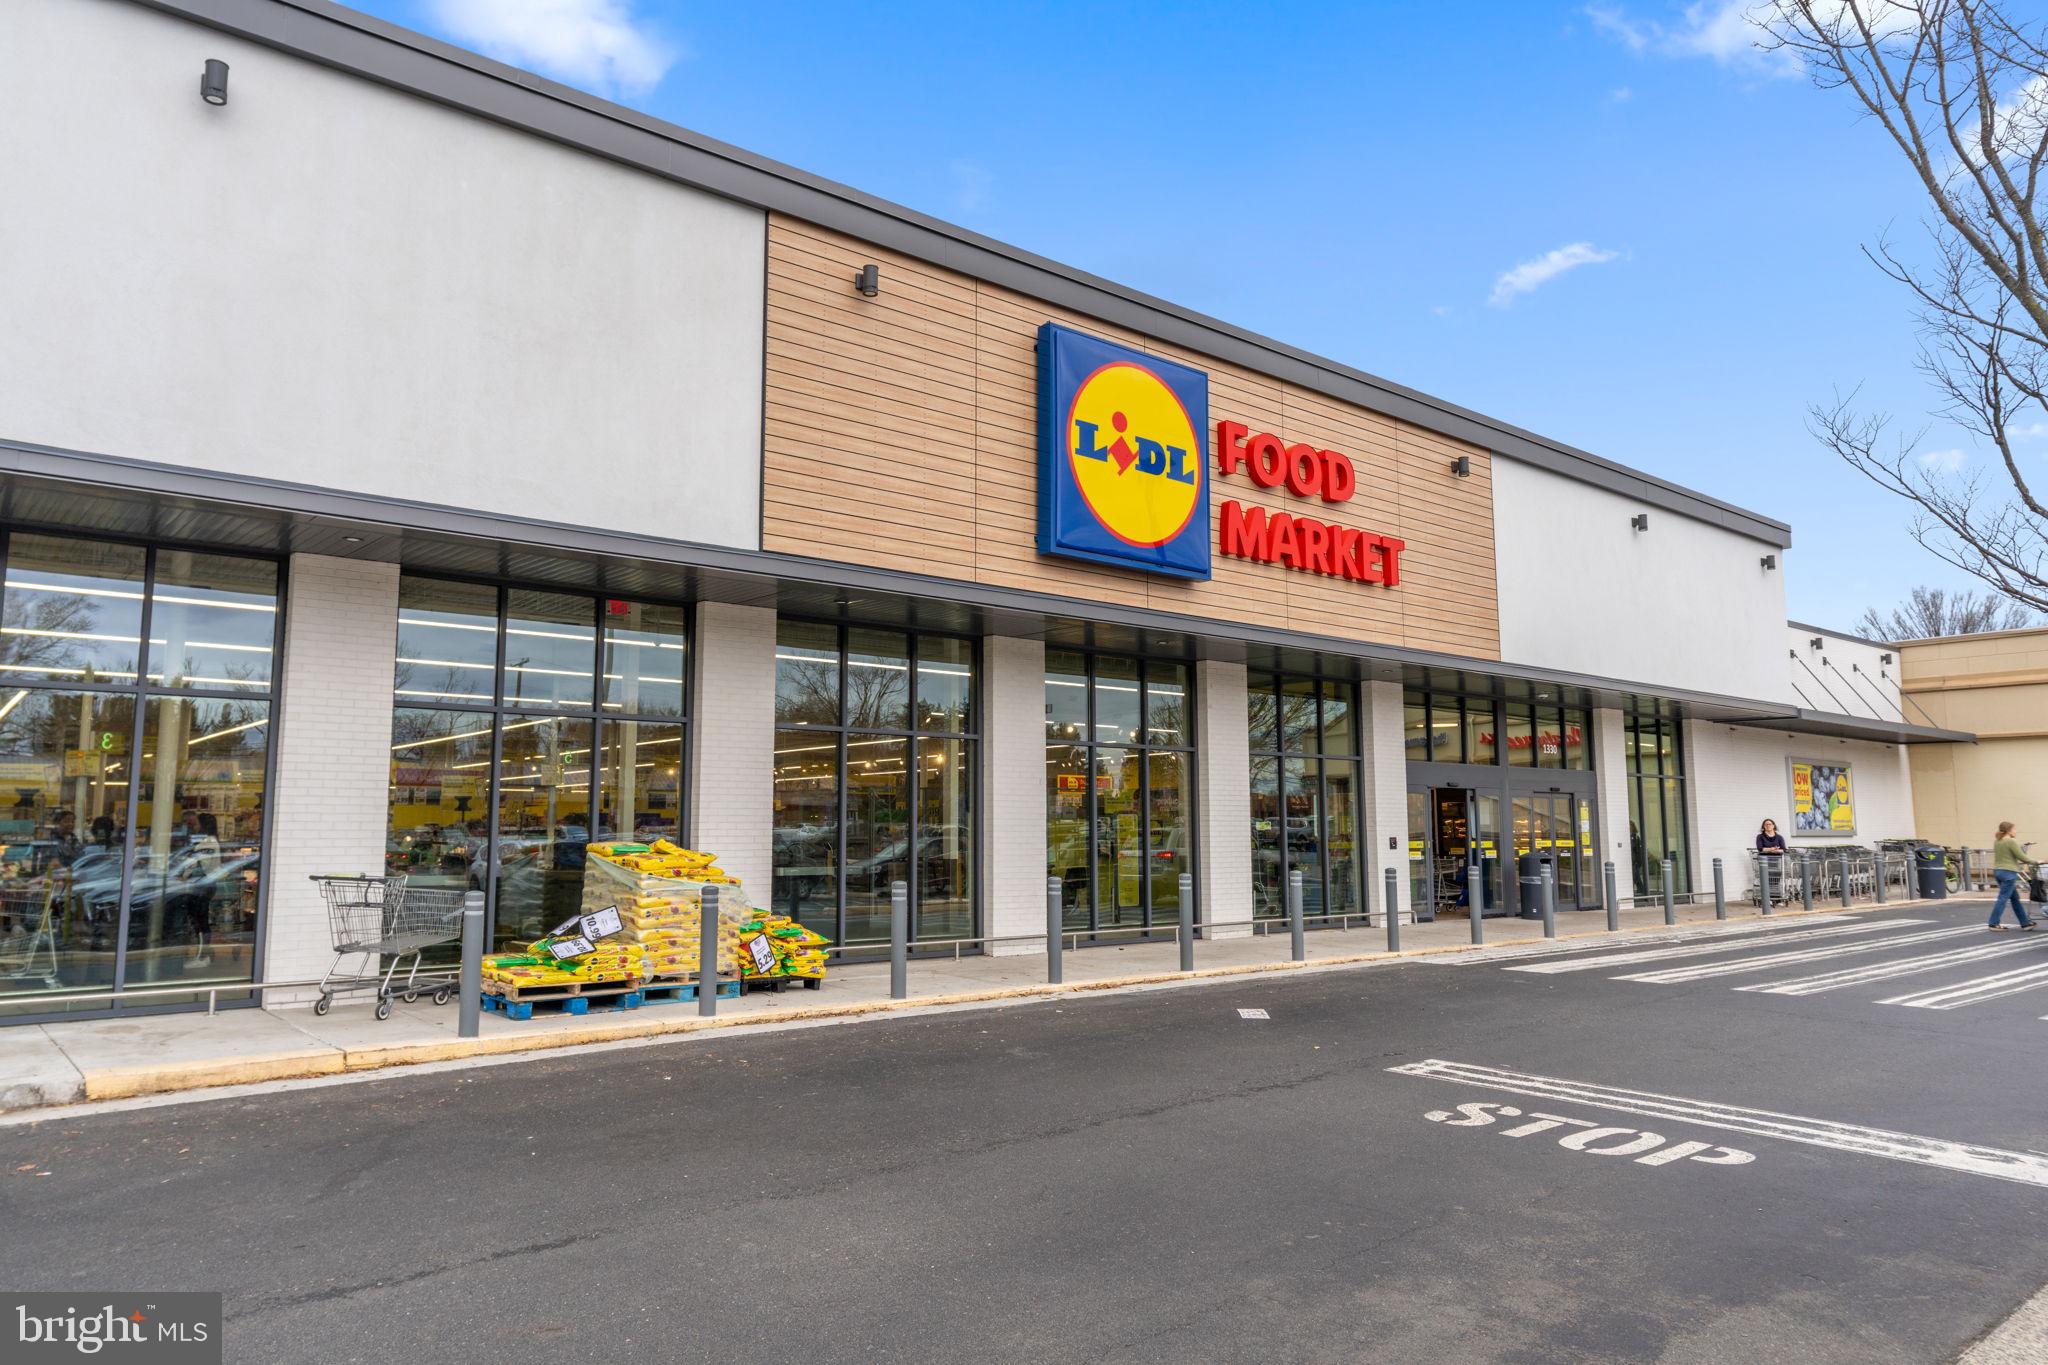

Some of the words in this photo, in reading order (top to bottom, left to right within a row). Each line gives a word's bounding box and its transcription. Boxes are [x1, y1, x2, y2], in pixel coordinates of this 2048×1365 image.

[1217, 420, 1355, 503] FOOD
[1219, 500, 1405, 587] MARKET
[1543, 743, 1558, 755] 1330
[586, 916, 601, 940] 10.99
[757, 950, 773, 970] 5.29
[1424, 1102, 1757, 1166] STOP
